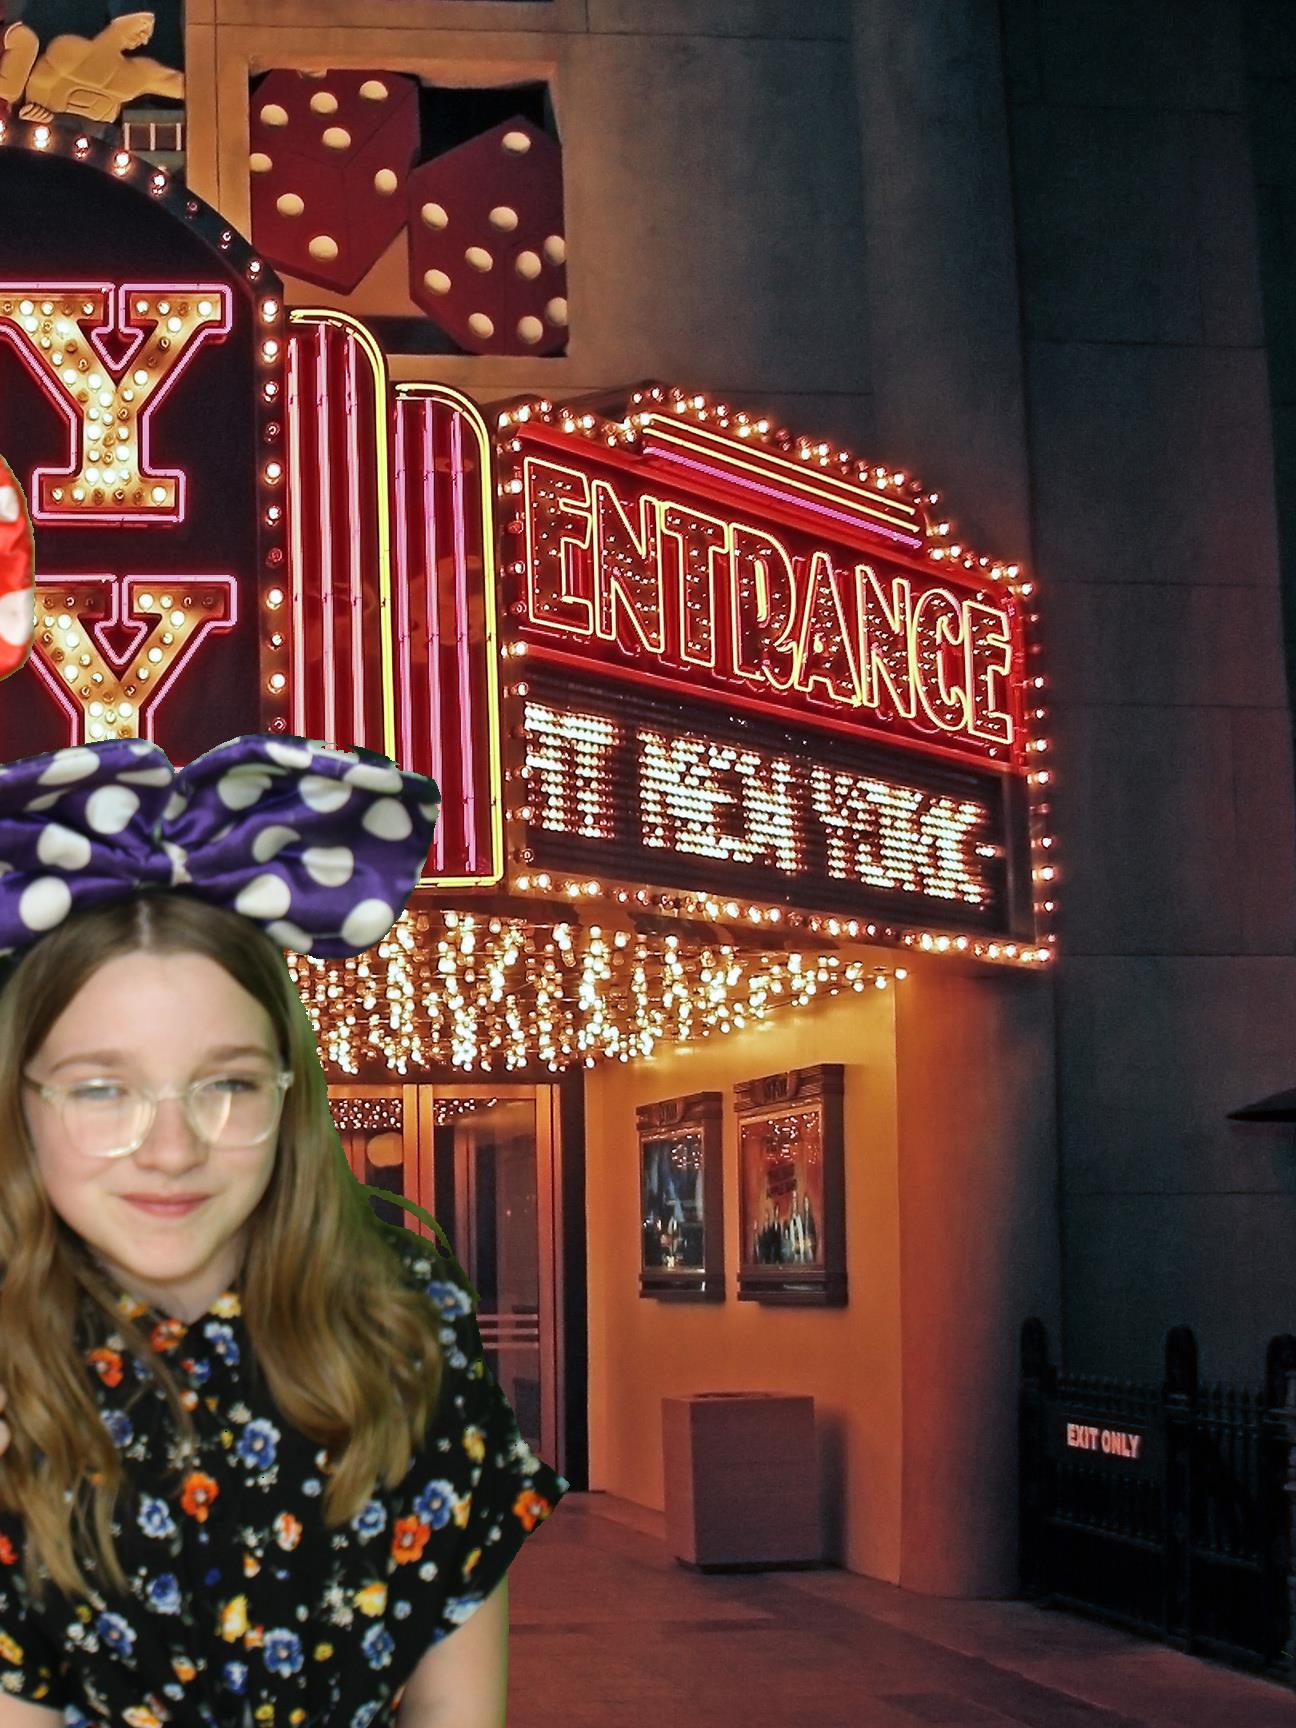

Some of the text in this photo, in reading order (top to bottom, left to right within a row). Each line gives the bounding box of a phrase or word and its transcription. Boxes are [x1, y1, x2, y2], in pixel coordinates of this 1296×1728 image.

[523, 456, 1014, 744] ENTRANCE
[1066, 1422, 1141, 1458] EXIT ONLY
